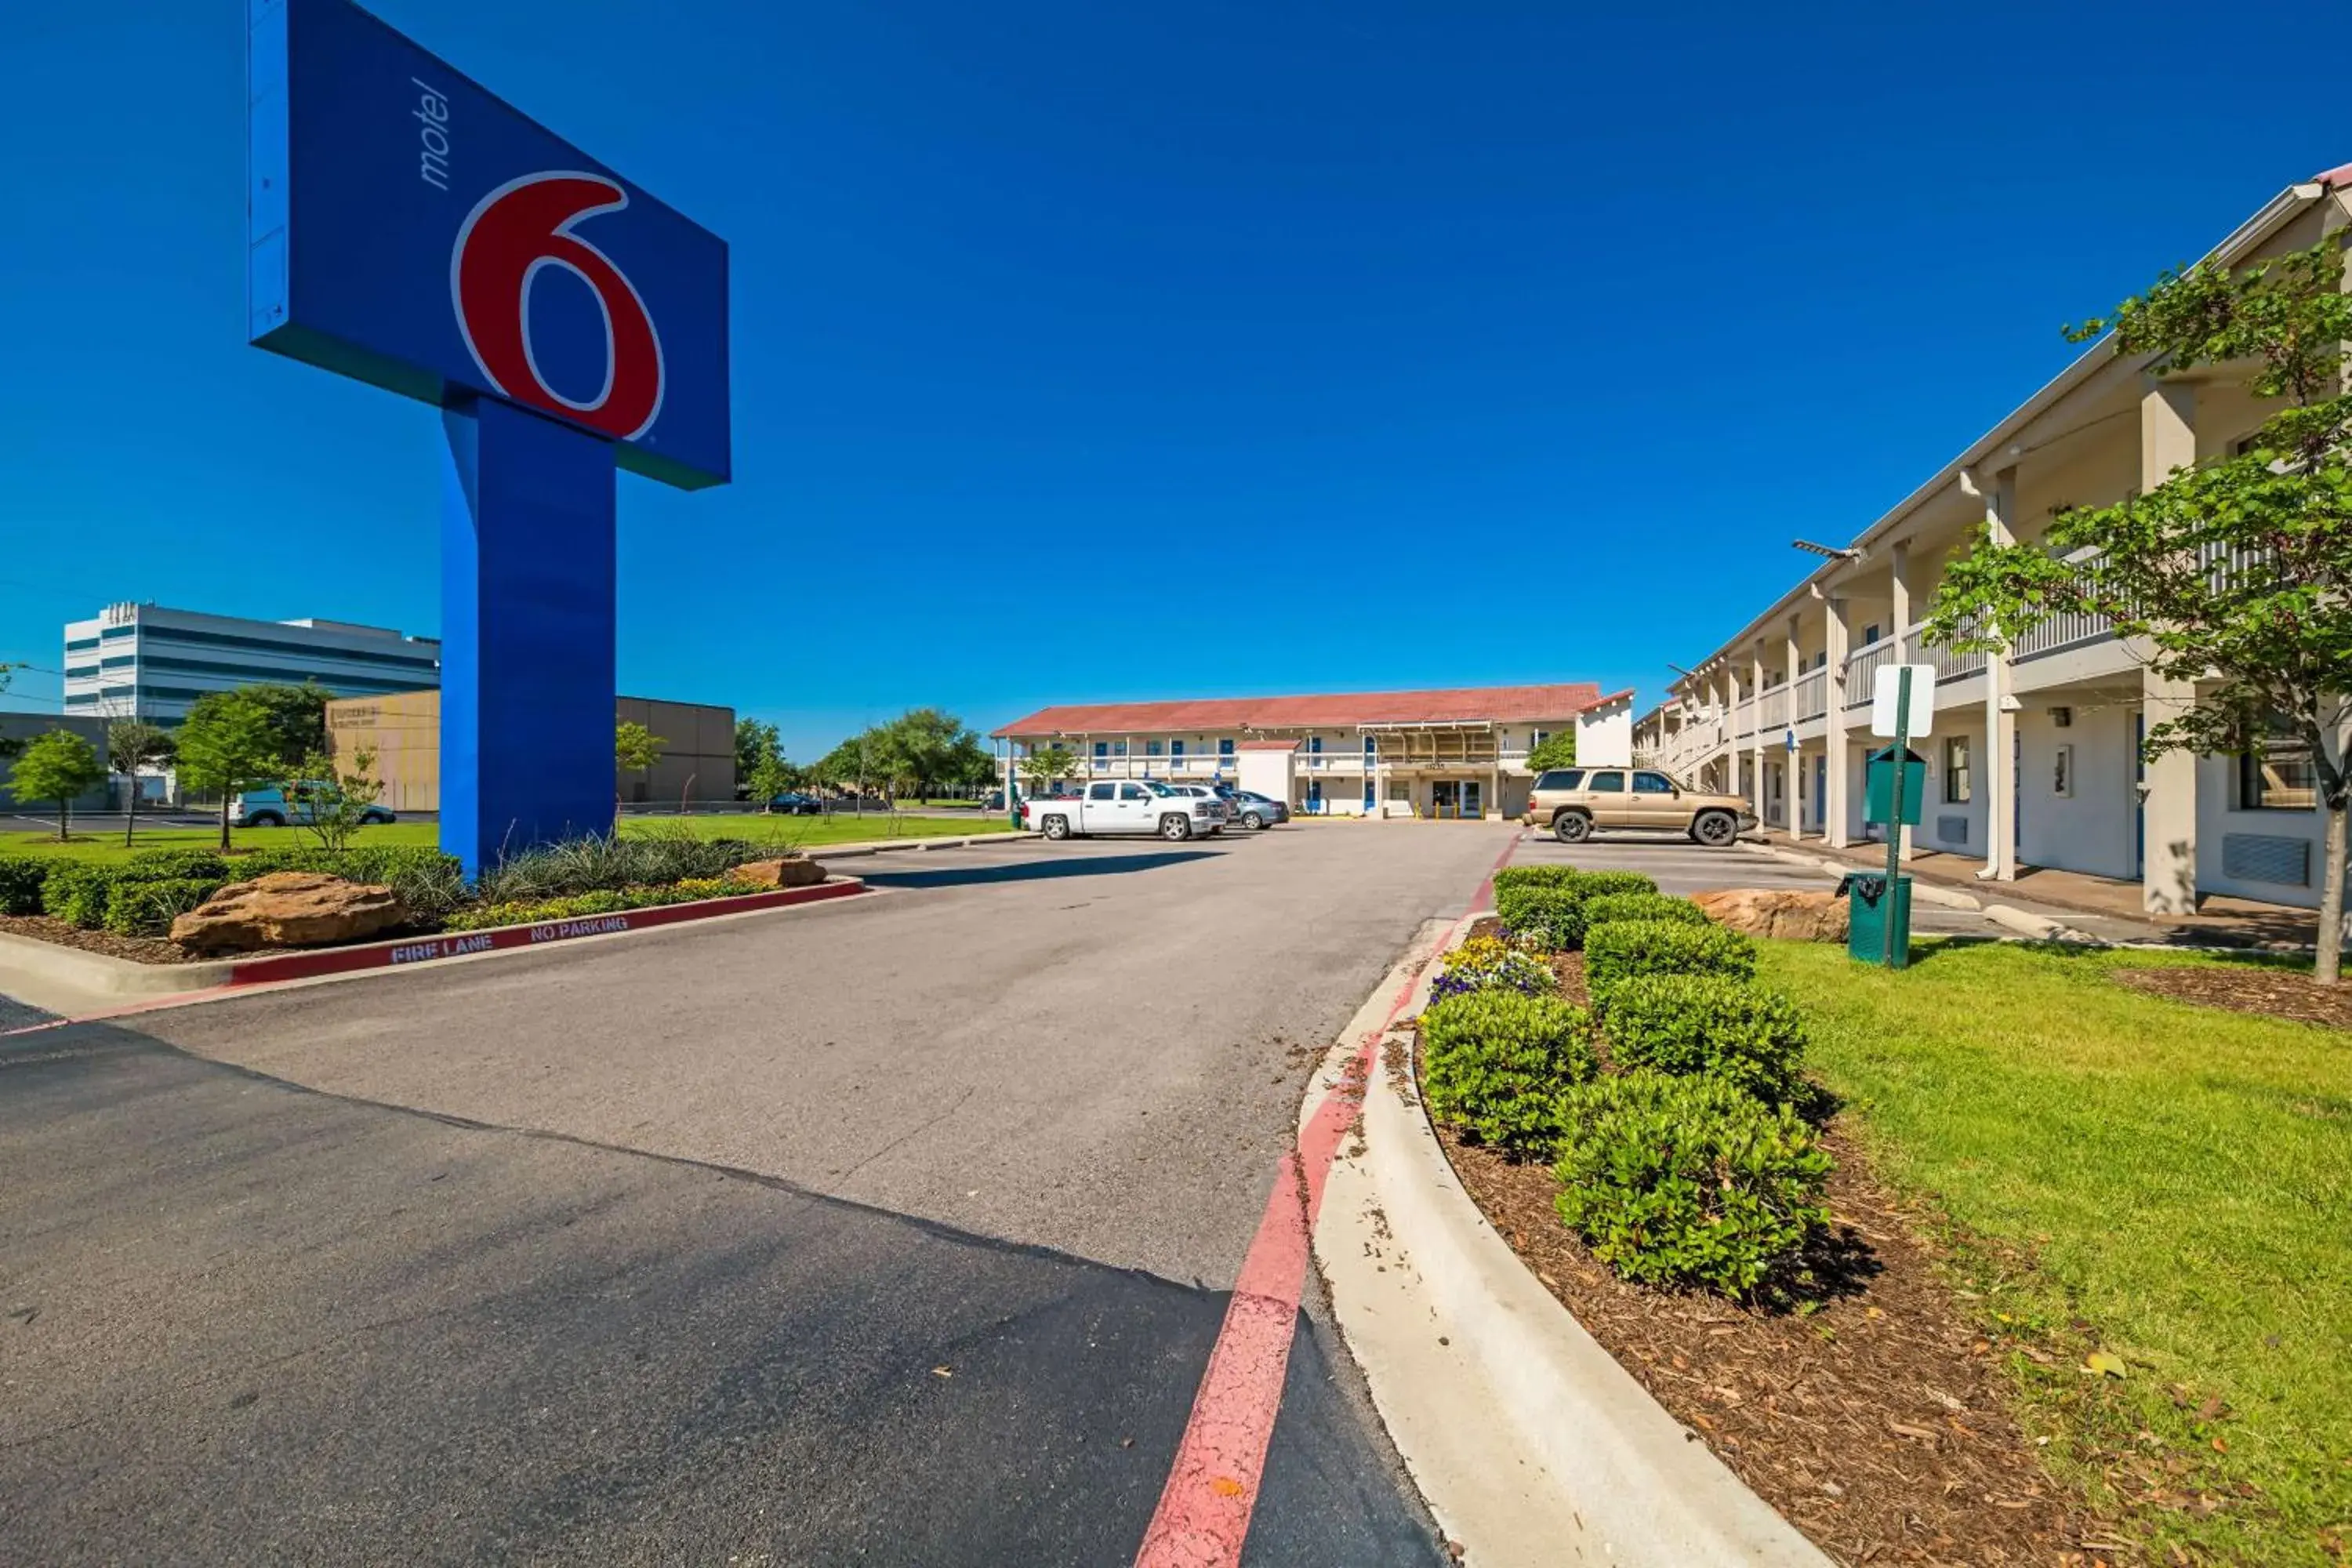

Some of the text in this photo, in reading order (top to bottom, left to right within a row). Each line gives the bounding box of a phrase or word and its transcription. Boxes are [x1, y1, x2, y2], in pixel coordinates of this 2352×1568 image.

[411, 77, 448, 191] motel
[450, 170, 665, 441] 6
[391, 934, 492, 964] FIRE LANE
[531, 916, 628, 941] NO PARKING
